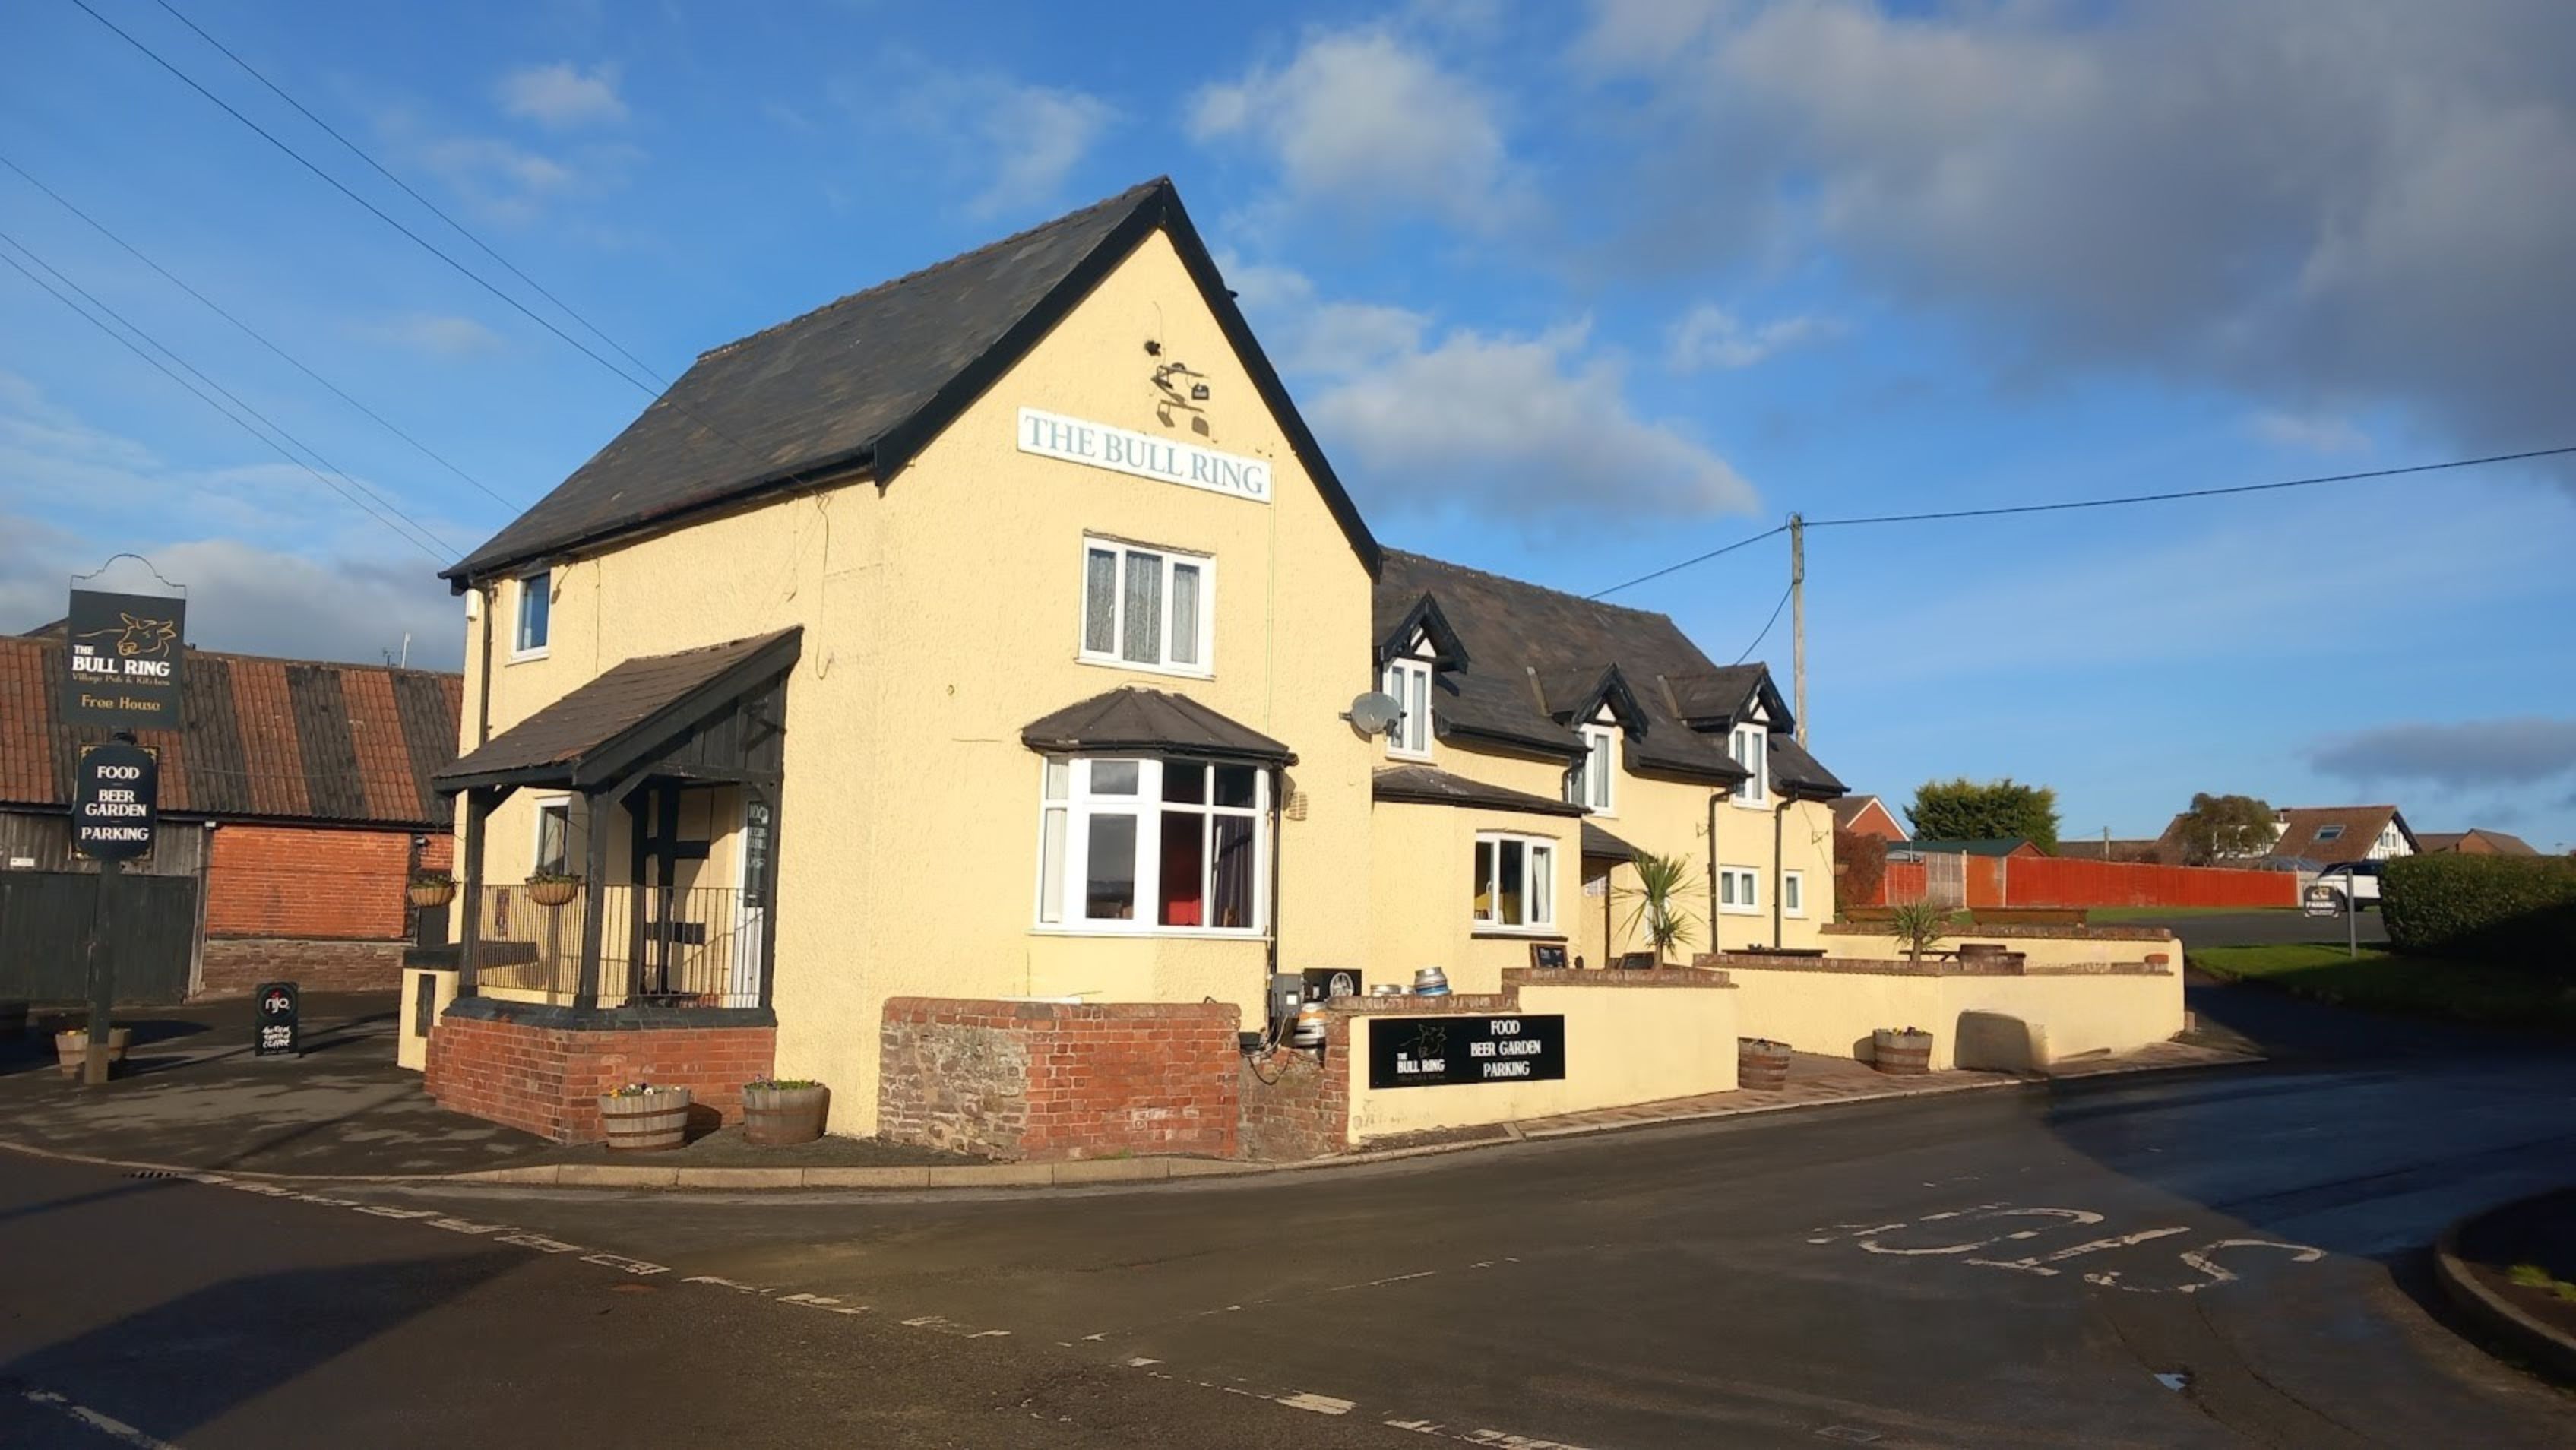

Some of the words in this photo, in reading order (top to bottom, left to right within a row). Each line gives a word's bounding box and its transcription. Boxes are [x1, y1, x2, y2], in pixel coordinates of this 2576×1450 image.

[1025, 415, 1097, 457] THE
[1104, 432, 1183, 476] BULL
[1191, 451, 1264, 494] RING
[73, 644, 95, 656] THE
[71, 656, 119, 674] BULL
[124, 658, 171, 676] RING
[81, 694, 114, 709] Free
[119, 697, 161, 711] House
[97, 765, 141, 780] FOOD
[98, 790, 135, 803] BEER
[84, 803, 147, 817] GARDEN
[81, 826, 150, 841] PARKING
[1490, 1020, 1521, 1036] FOOD
[1470, 1041, 1496, 1057] BEER
[1498, 1039, 1542, 1056] GARDEN
[1397, 1059, 1420, 1074] BULL
[1422, 1058, 1446, 1072] RING
[1483, 1060, 1530, 1078] PARKING
